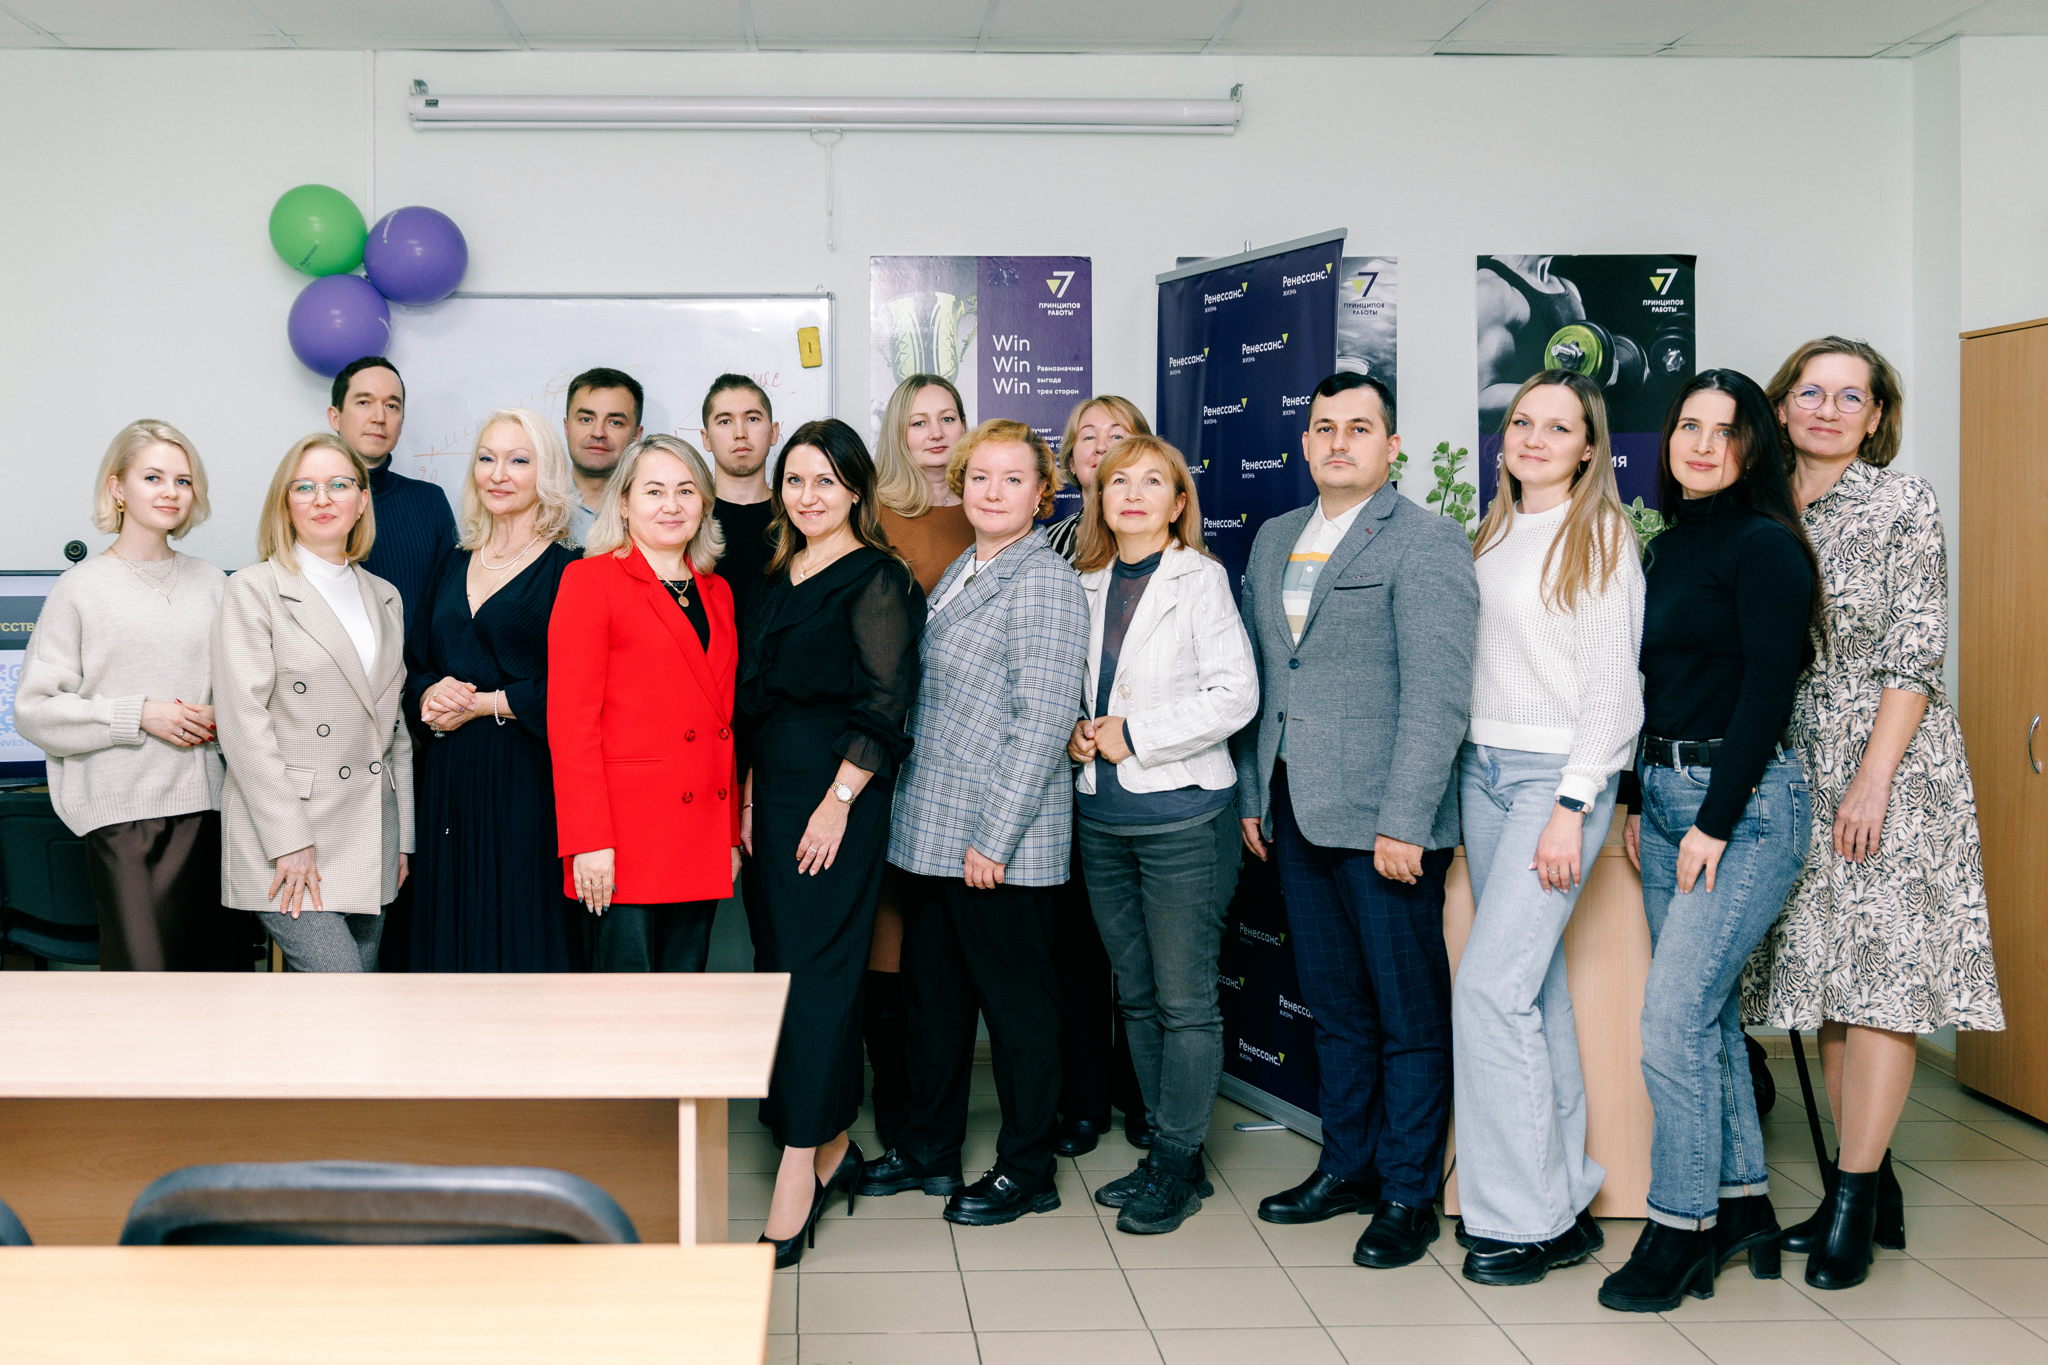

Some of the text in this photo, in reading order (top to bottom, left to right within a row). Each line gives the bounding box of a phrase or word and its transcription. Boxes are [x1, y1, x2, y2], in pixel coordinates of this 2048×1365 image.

[1053, 271, 1076, 298] 7
[1357, 271, 1379, 298] 7
[1656, 268, 1679, 296] 7
[1038, 302, 1081, 310] ПРИНЦИПОВ
[1343, 302, 1385, 310] ПРИНЦИПОВ
[992, 334, 1031, 352] Win
[992, 356, 1031, 373] Win
[992, 377, 1031, 395] Win
[1282, 395, 1311, 407] Ренесс
[1279, 994, 1314, 1019] Ренесса
